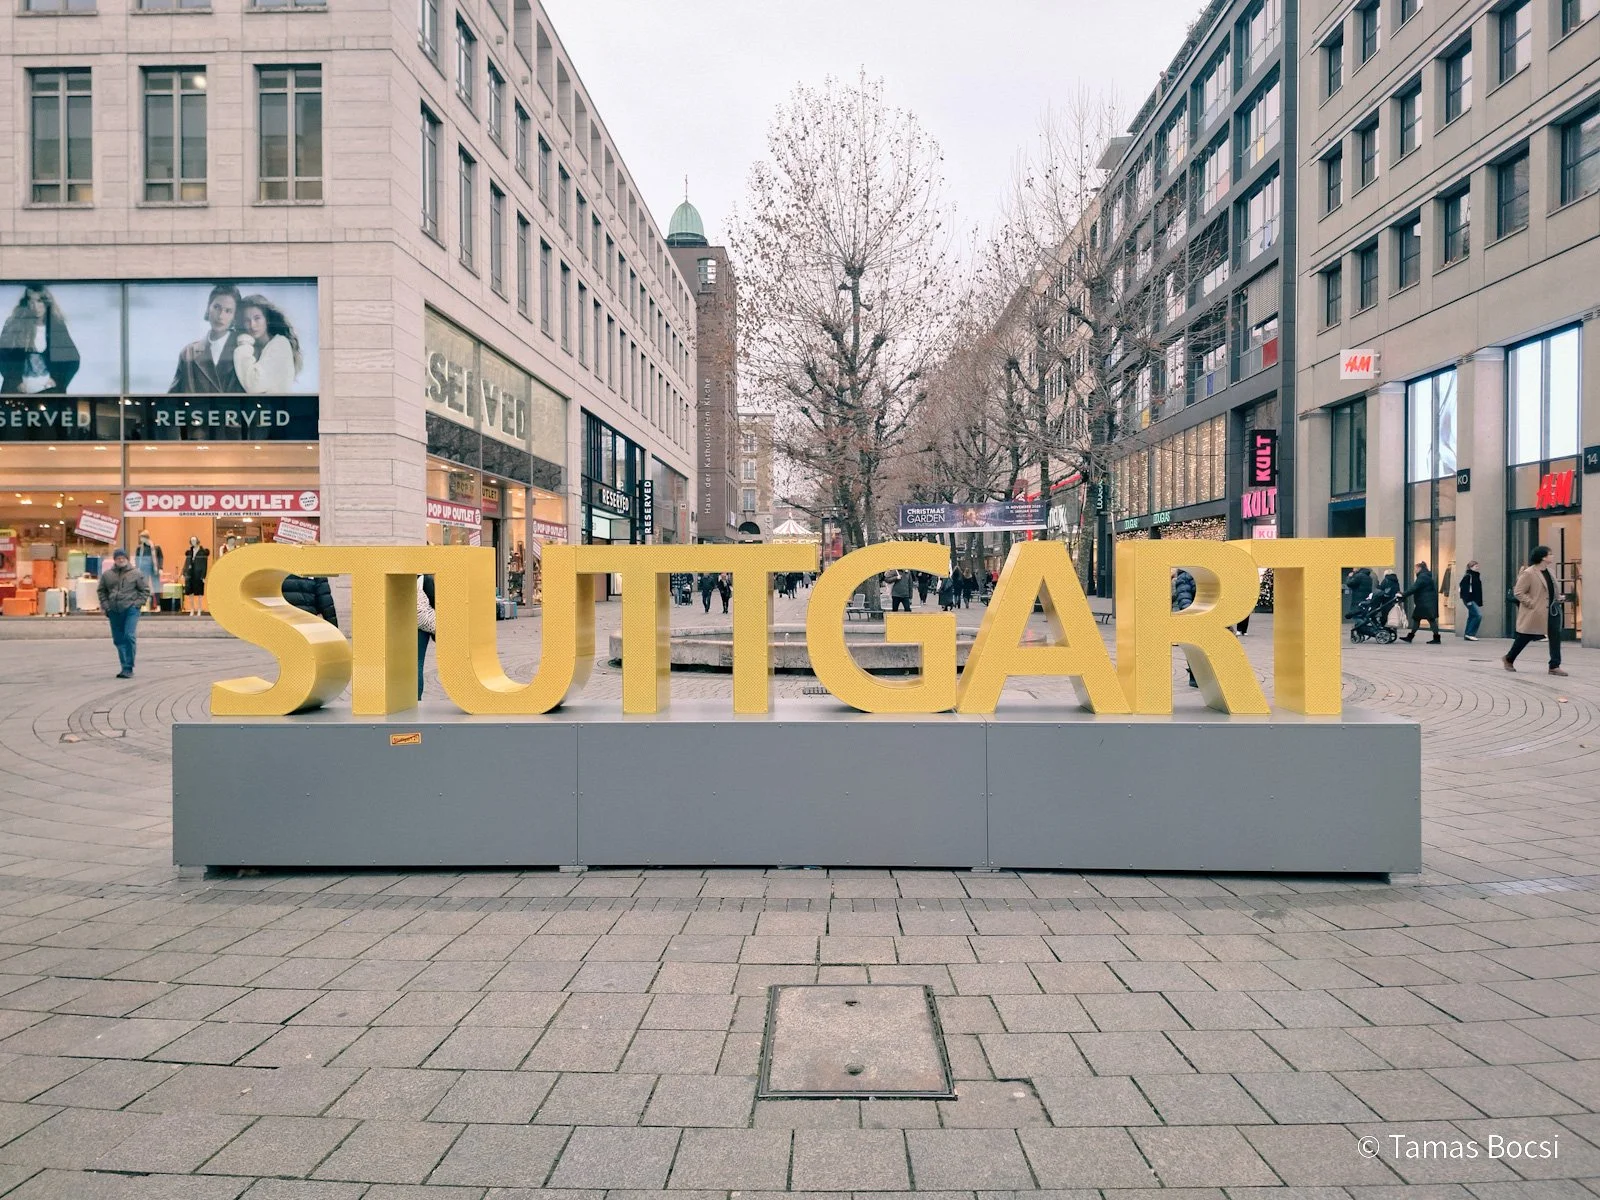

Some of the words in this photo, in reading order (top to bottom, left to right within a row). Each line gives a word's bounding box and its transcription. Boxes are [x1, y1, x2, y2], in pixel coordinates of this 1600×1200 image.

[1345, 355, 1371, 373] H&M
[0, 410, 91, 428] SERVED
[156, 410, 290, 427] RESERVED
[1256, 435, 1271, 482] KULT
[1587, 452, 1598, 465] 14
[1536, 469, 1574, 510] H&M
[147, 494, 186, 510] POP
[189, 494, 216, 510] UP
[219, 494, 294, 510] OUTLET
[644, 481, 652, 534] RESERVED
[1241, 487, 1277, 518] KULT
[428, 503, 442, 517] POP
[442, 505, 452, 519] UP
[452, 507, 474, 522] OUTLET
[906, 514, 945, 523] GARDEN
[207, 537, 1395, 716] STUTTGART
